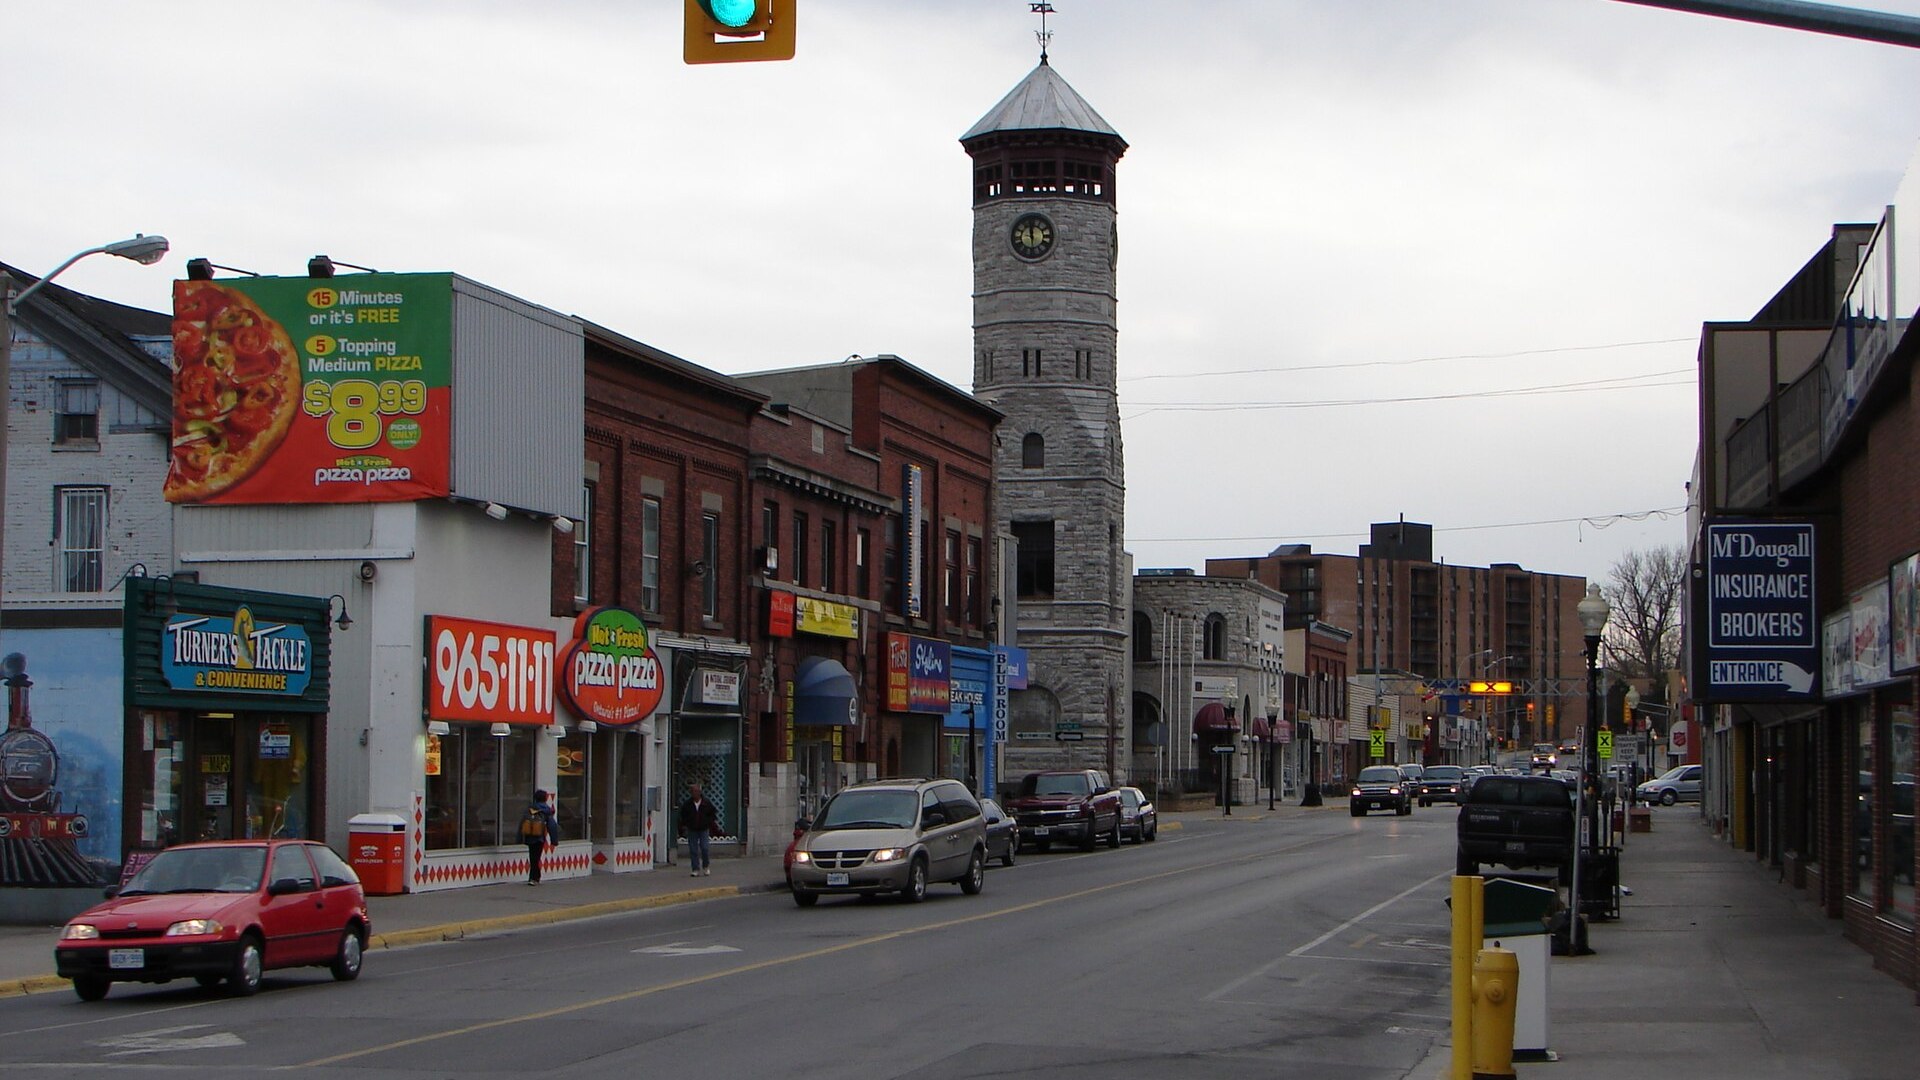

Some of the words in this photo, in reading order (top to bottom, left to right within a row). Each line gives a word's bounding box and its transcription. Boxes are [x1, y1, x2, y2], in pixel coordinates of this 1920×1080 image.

[312, 292, 331, 306] 15
[340, 291, 404, 305] Minutes
[310, 314, 327, 325] or
[330, 310, 354, 324] it's
[358, 308, 400, 323] FREE
[316, 340, 326, 353] 5
[338, 338, 396, 356] Topping
[308, 358, 371, 372] Medium
[375, 356, 422, 371] PIZZA
[315, 468, 363, 486] pizza
[366, 467, 411, 486] pizza
[1712, 533, 1811, 568] McDougall
[1715, 574, 1808, 598] INSURANCE
[1720, 612, 1804, 637] BROKERS
[168, 617, 239, 666] TURNER'S
[250, 624, 307, 672] TACKLE
[592, 624, 610, 645] Hot
[616, 626, 645, 649] Fresh
[196, 672, 205, 686] &
[207, 671, 287, 690] CONVENIENCE
[575, 651, 615, 697] pizza
[618, 655, 657, 699] pizza
[996, 653, 1007, 696] BLUE
[1712, 662, 1783, 683] ENTRANCE
[964, 693, 983, 704] HOUSE
[996, 699, 1007, 741] ROOM
